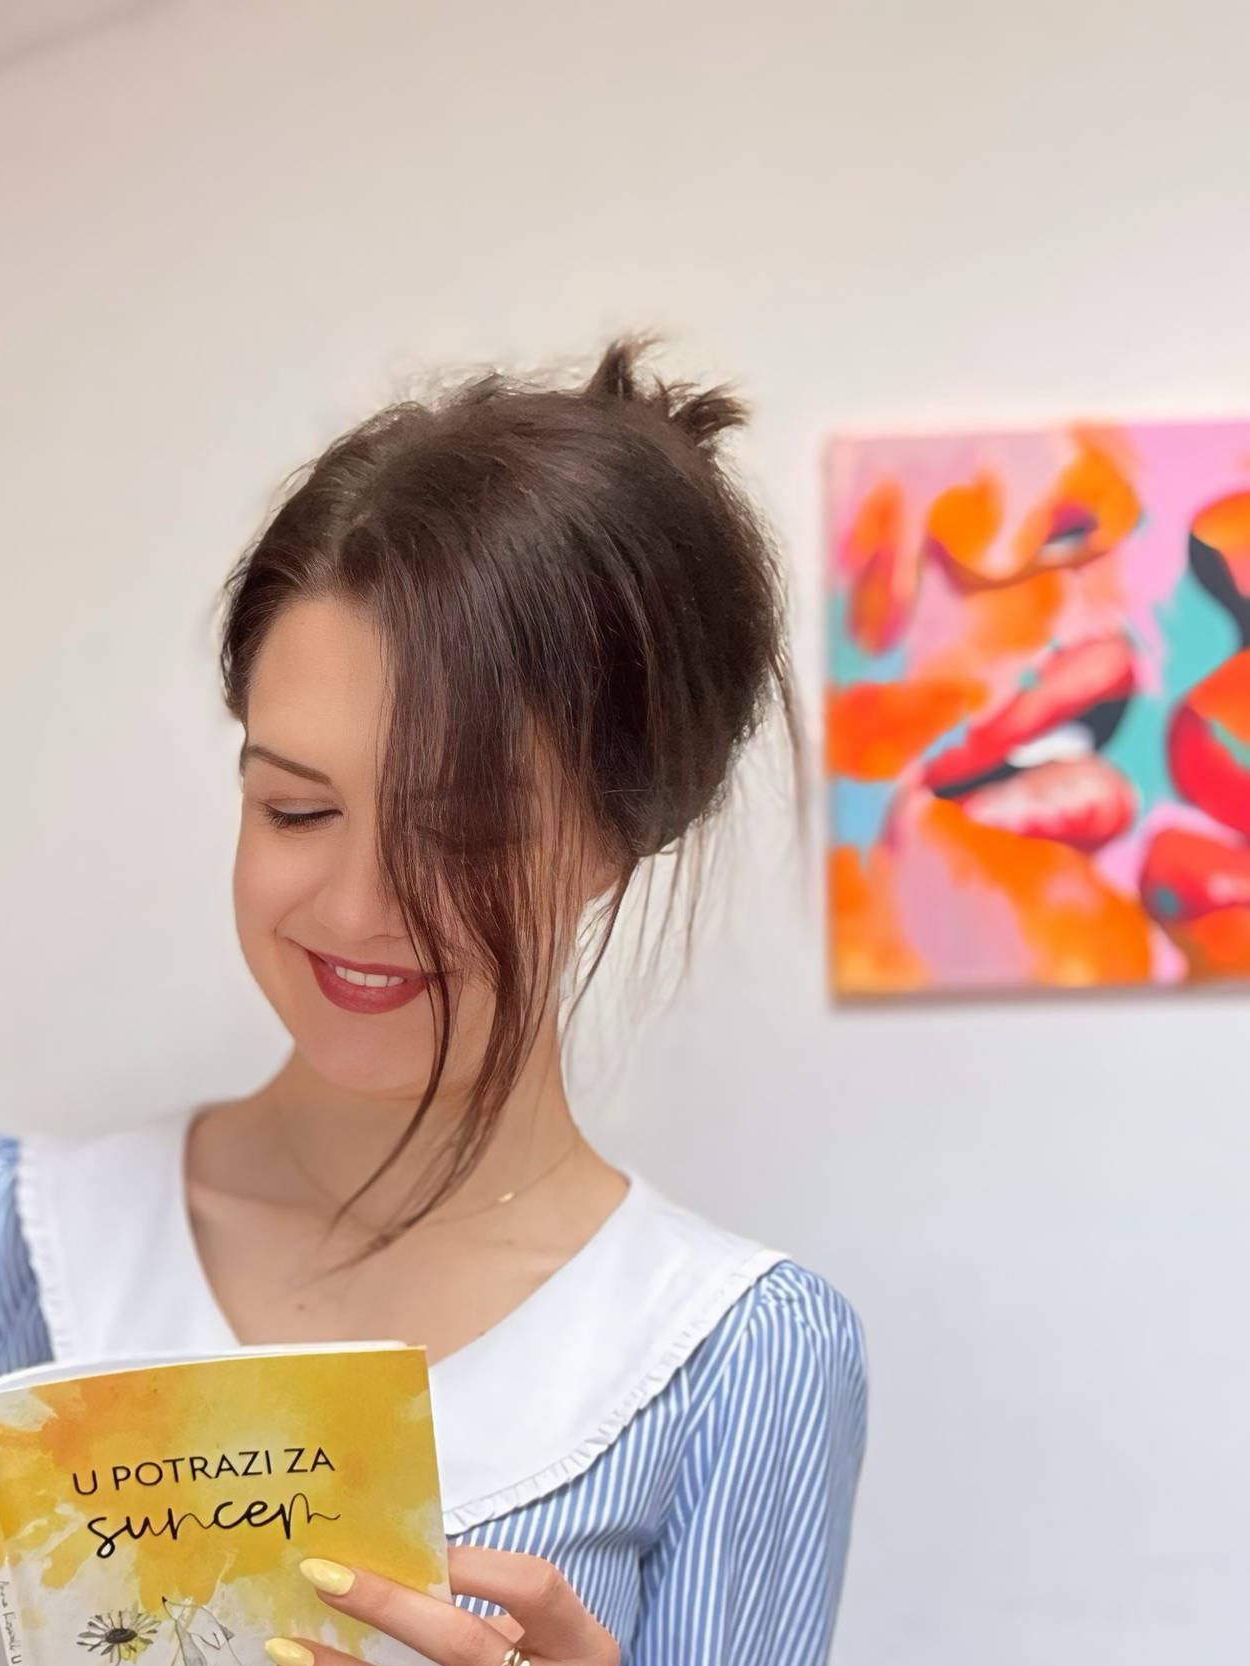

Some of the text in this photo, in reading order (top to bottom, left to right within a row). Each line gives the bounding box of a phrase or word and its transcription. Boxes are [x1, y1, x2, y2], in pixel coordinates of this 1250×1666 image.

[72, 1447, 335, 1495] U POTRAZI ZA
